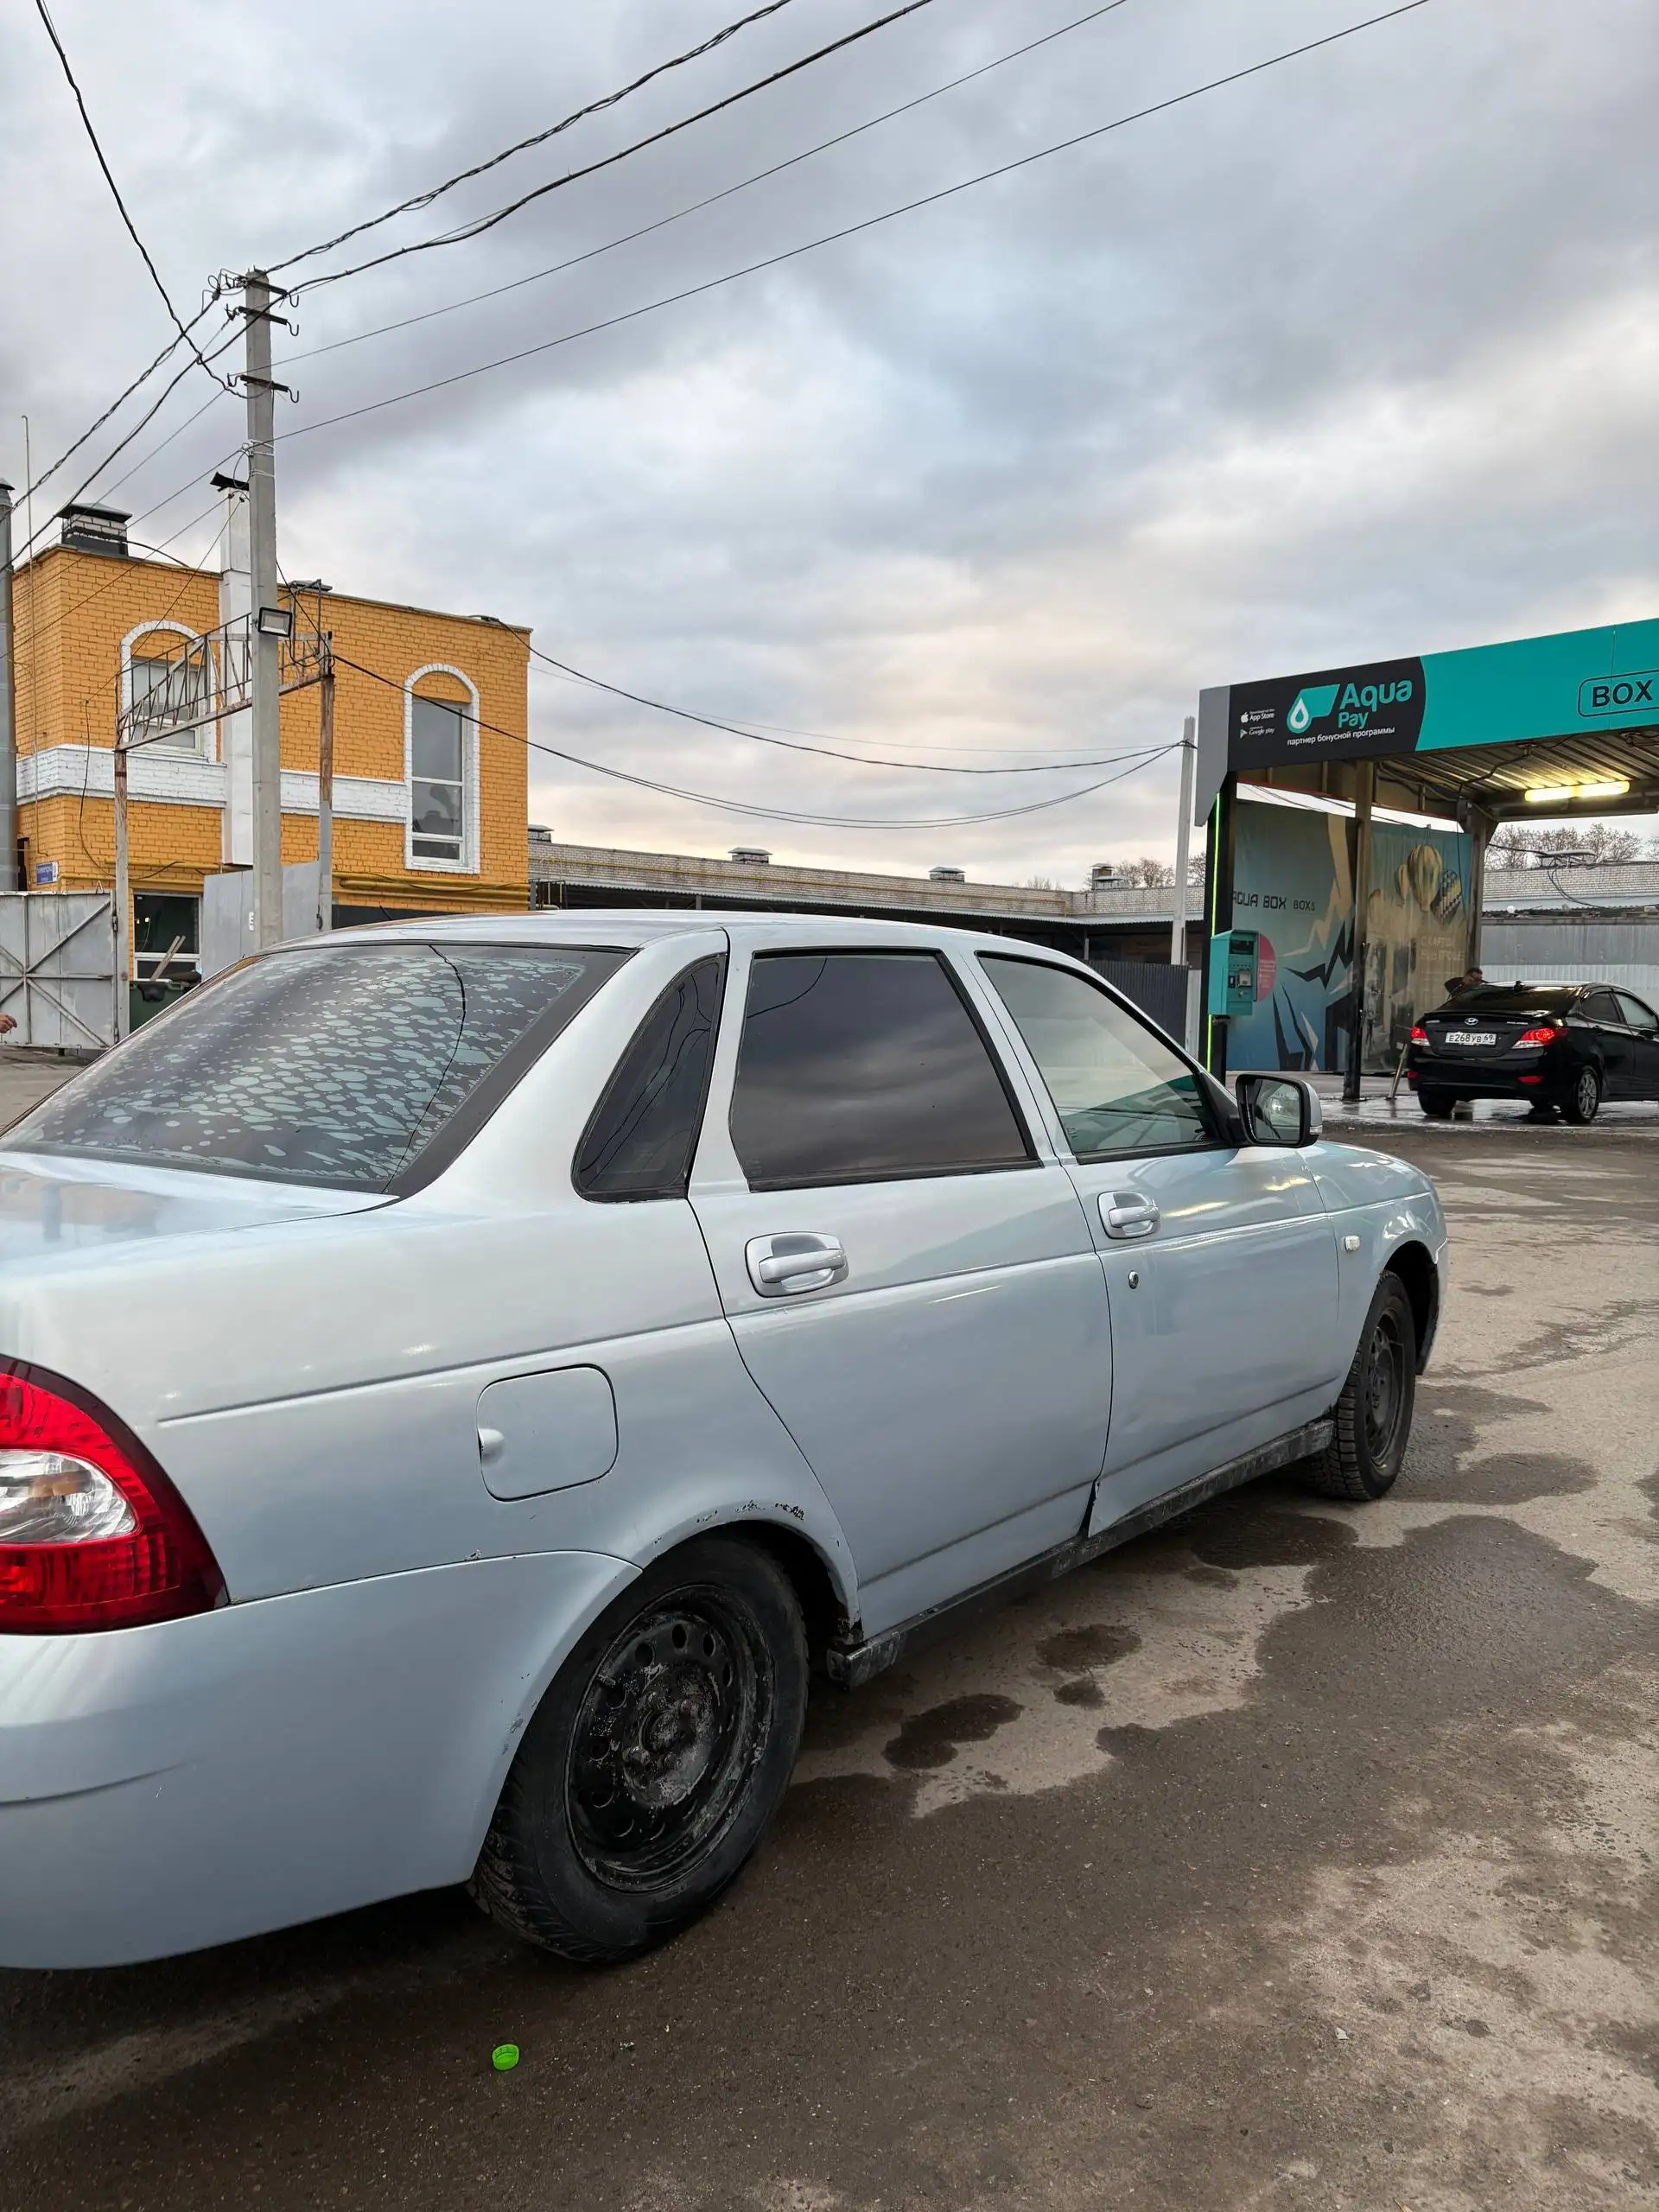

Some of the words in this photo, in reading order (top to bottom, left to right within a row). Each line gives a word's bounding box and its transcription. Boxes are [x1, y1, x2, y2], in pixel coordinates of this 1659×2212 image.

[1339, 679, 1413, 712] Aqua
[1592, 679, 1653, 708] BOX
[1338, 711, 1369, 729] Pay
[1287, 736, 1316, 746] партнер
[1317, 730, 1351, 743] бонусной
[1352, 727, 1395, 738] программы
[1262, 894, 1287, 910] BOX
